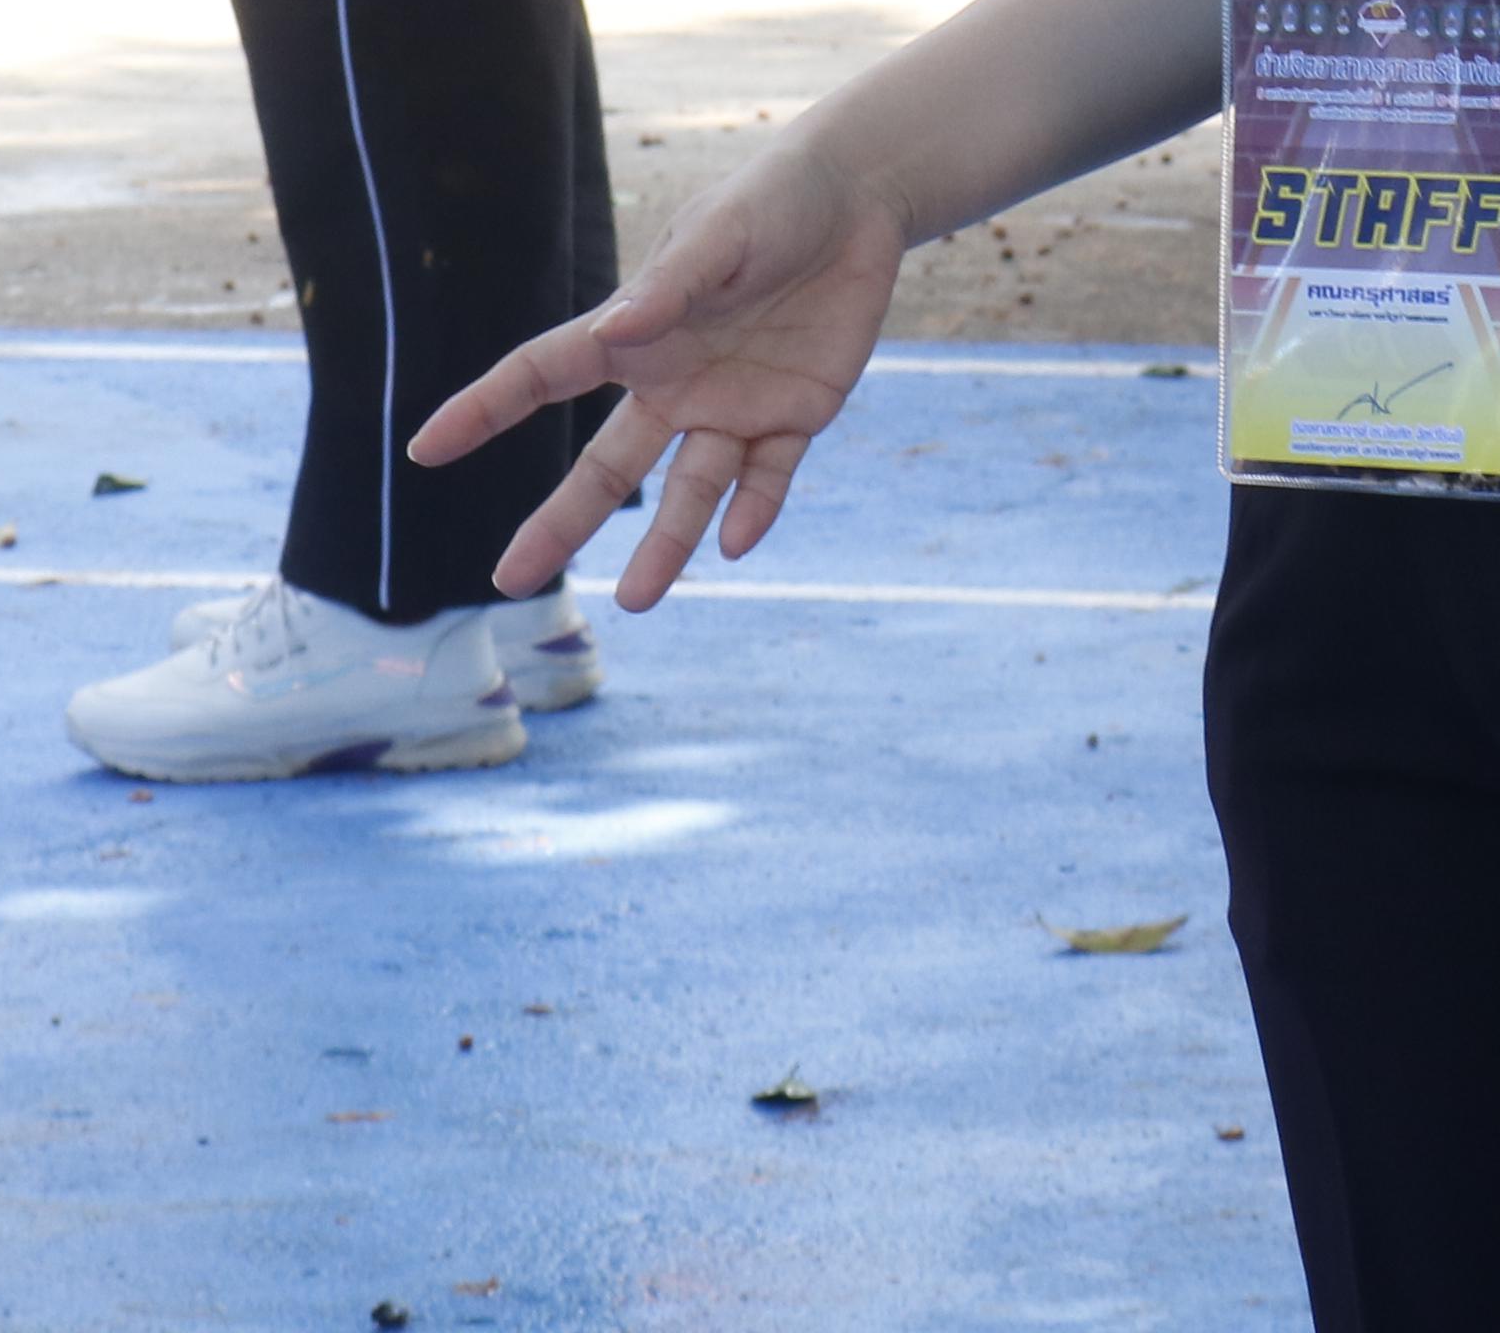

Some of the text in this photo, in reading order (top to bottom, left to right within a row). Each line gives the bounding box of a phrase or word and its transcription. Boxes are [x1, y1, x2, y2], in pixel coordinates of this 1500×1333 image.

[1307, 284, 1453, 308] คณะครุศาสตร์
